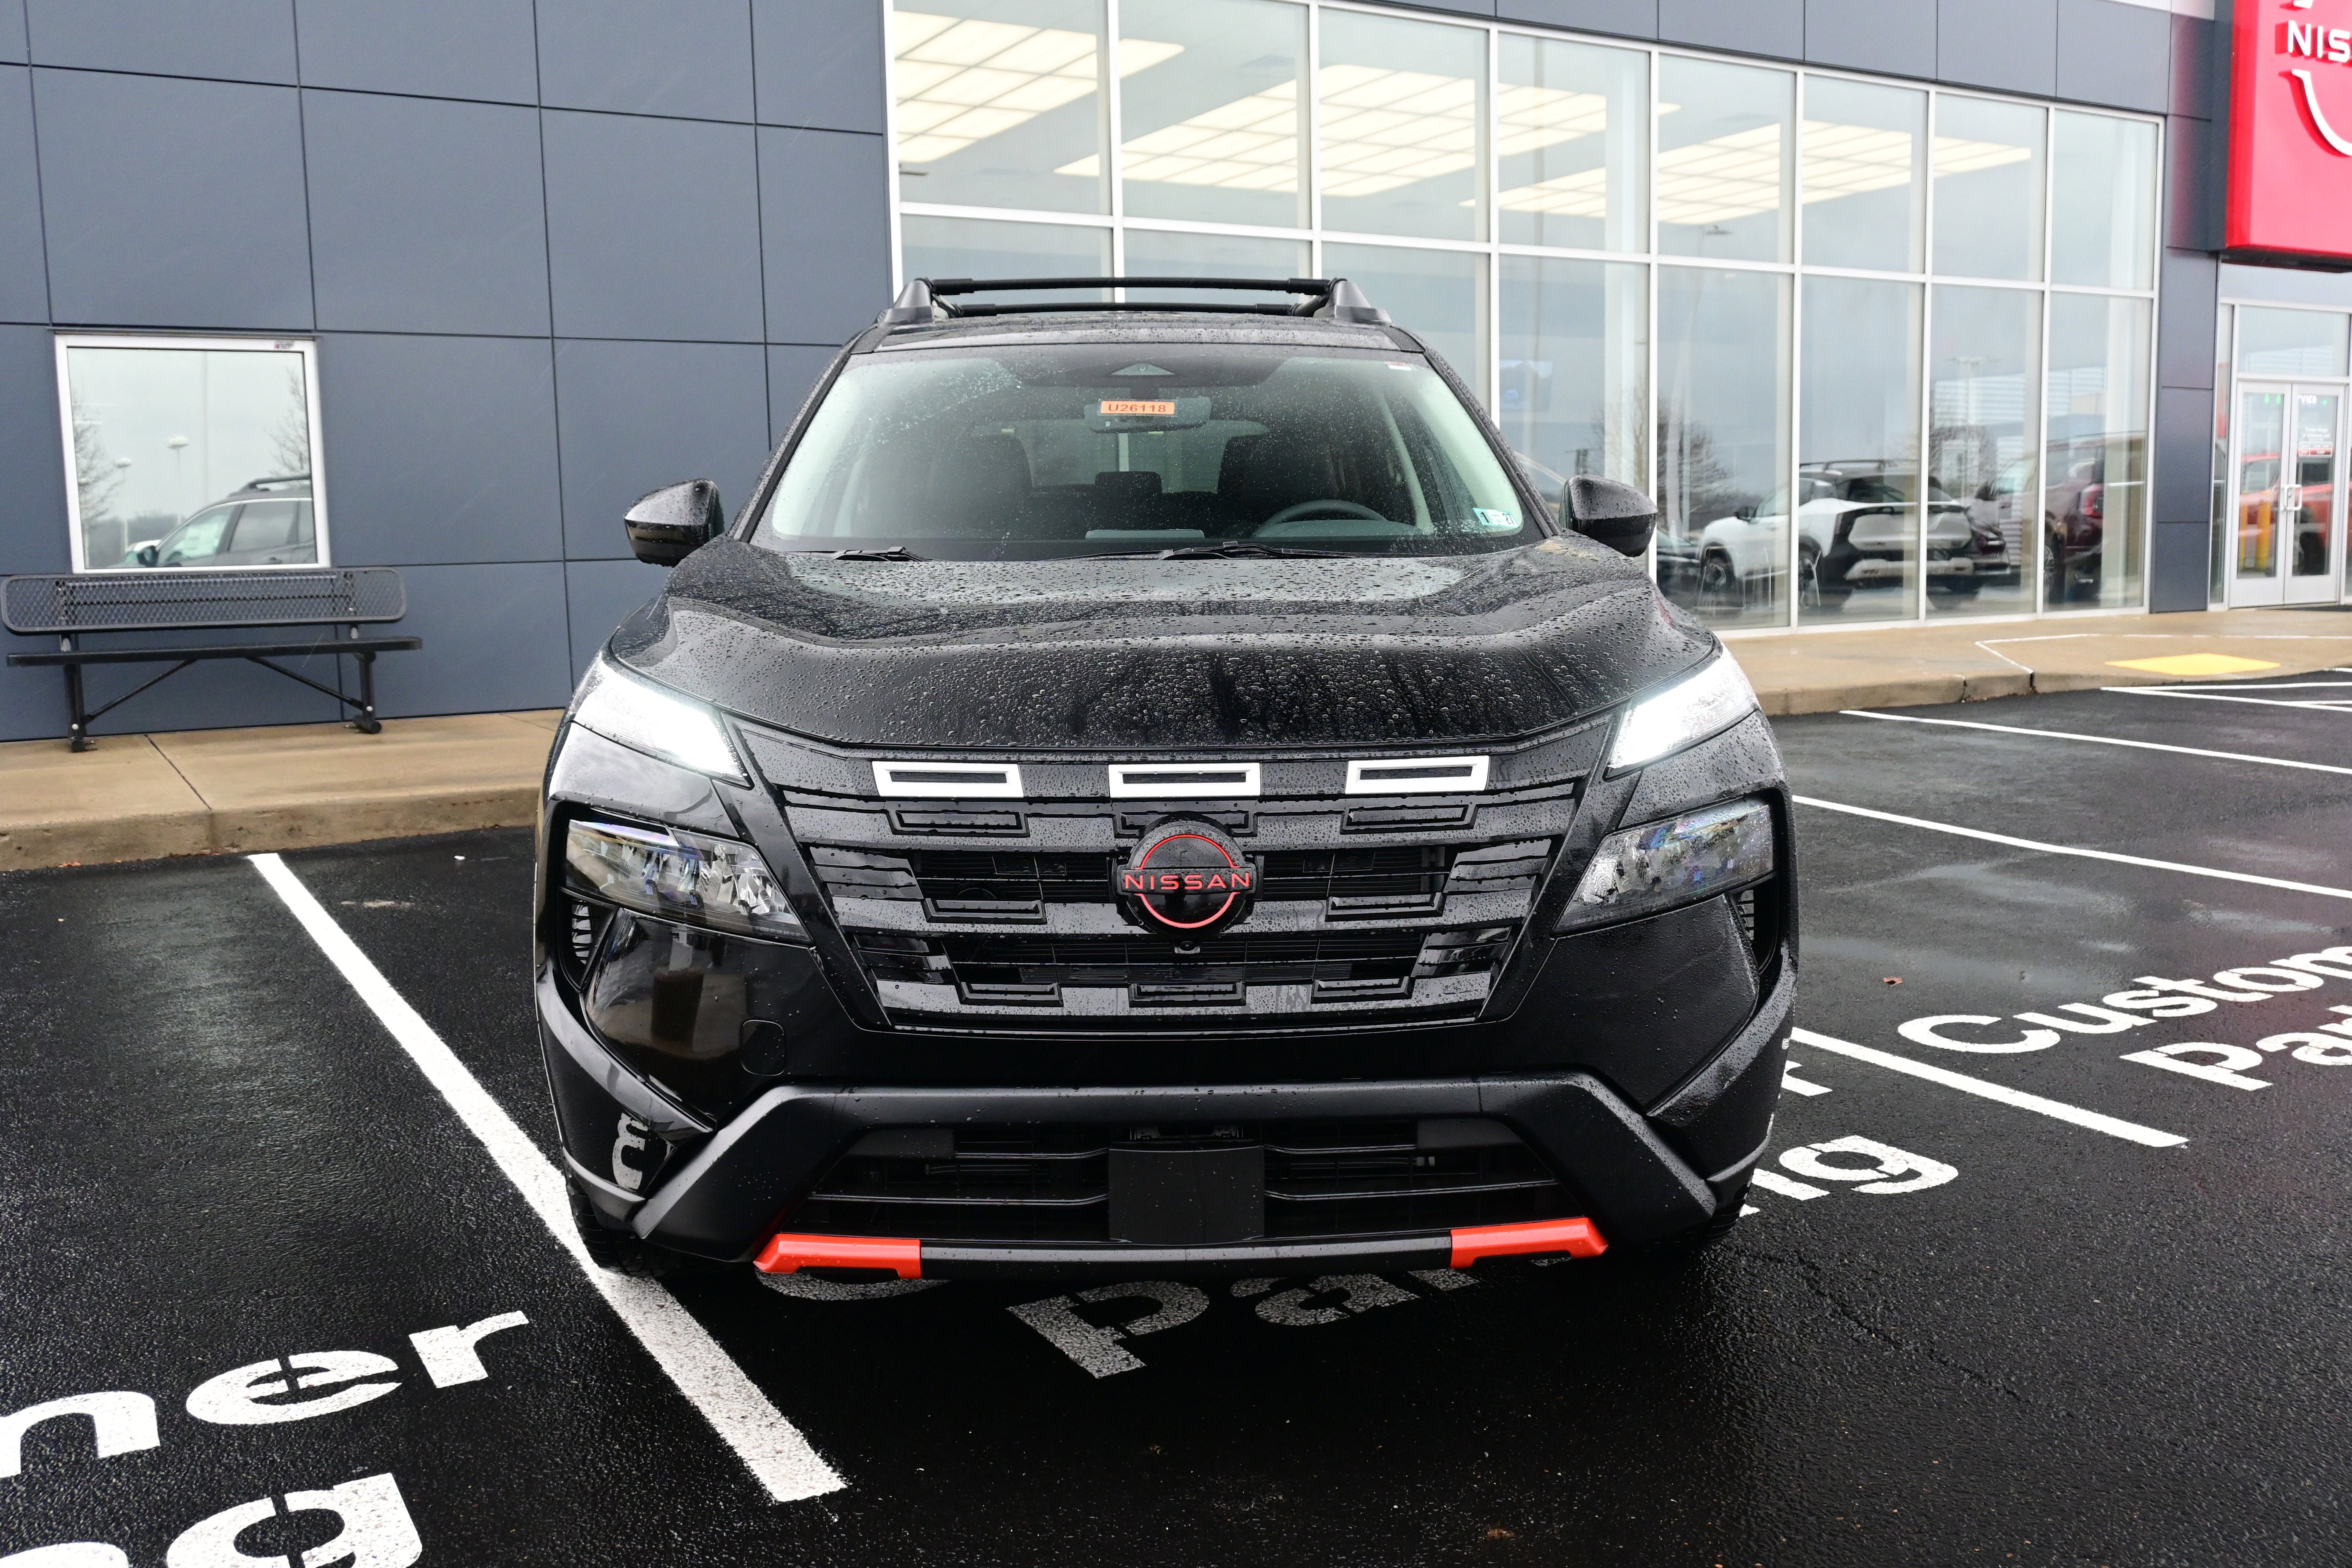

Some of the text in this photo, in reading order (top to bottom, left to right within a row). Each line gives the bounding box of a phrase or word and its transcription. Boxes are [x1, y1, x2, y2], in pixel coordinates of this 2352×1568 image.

[1108, 404, 1166, 412] U26118
[1502, 513, 1514, 525] 27
[1124, 871, 1250, 890] NISSAN
[2119, 1004, 2352, 1092] Pa
